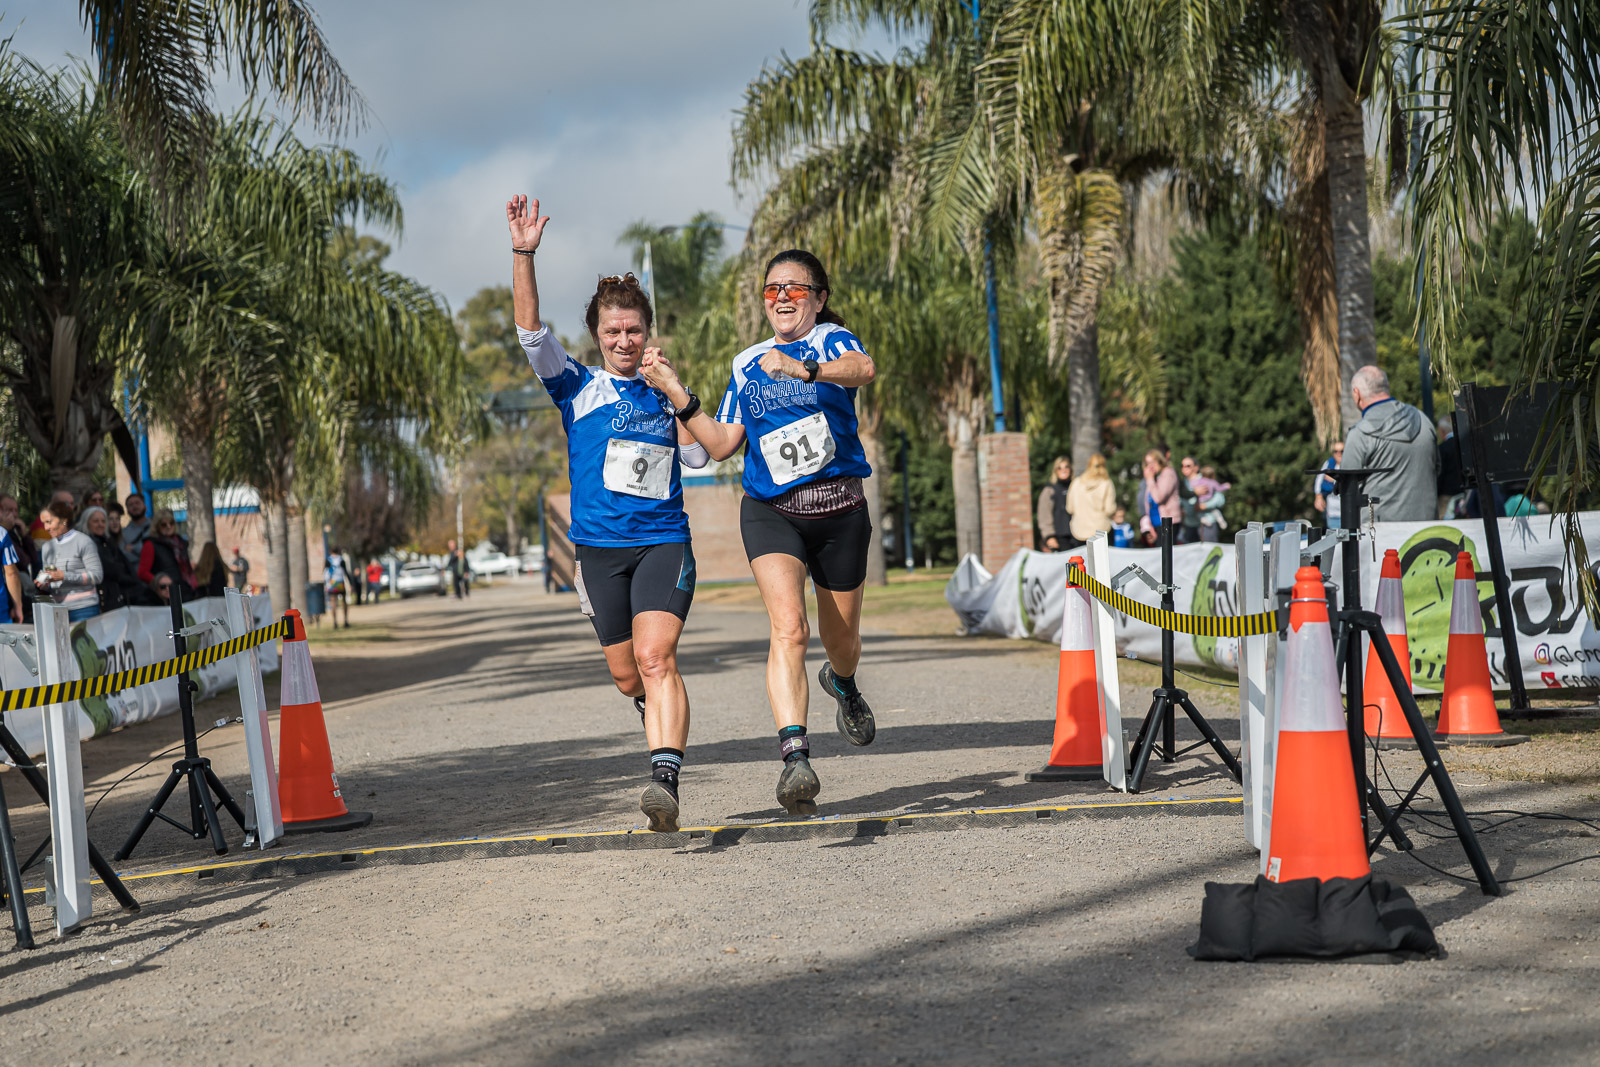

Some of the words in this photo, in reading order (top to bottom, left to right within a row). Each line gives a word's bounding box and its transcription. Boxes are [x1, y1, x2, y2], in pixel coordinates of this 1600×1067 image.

[745, 380, 765, 418] 3
[612, 401, 633, 432] 3
[780, 435, 820, 467] 91
[632, 457, 649, 483] 9
